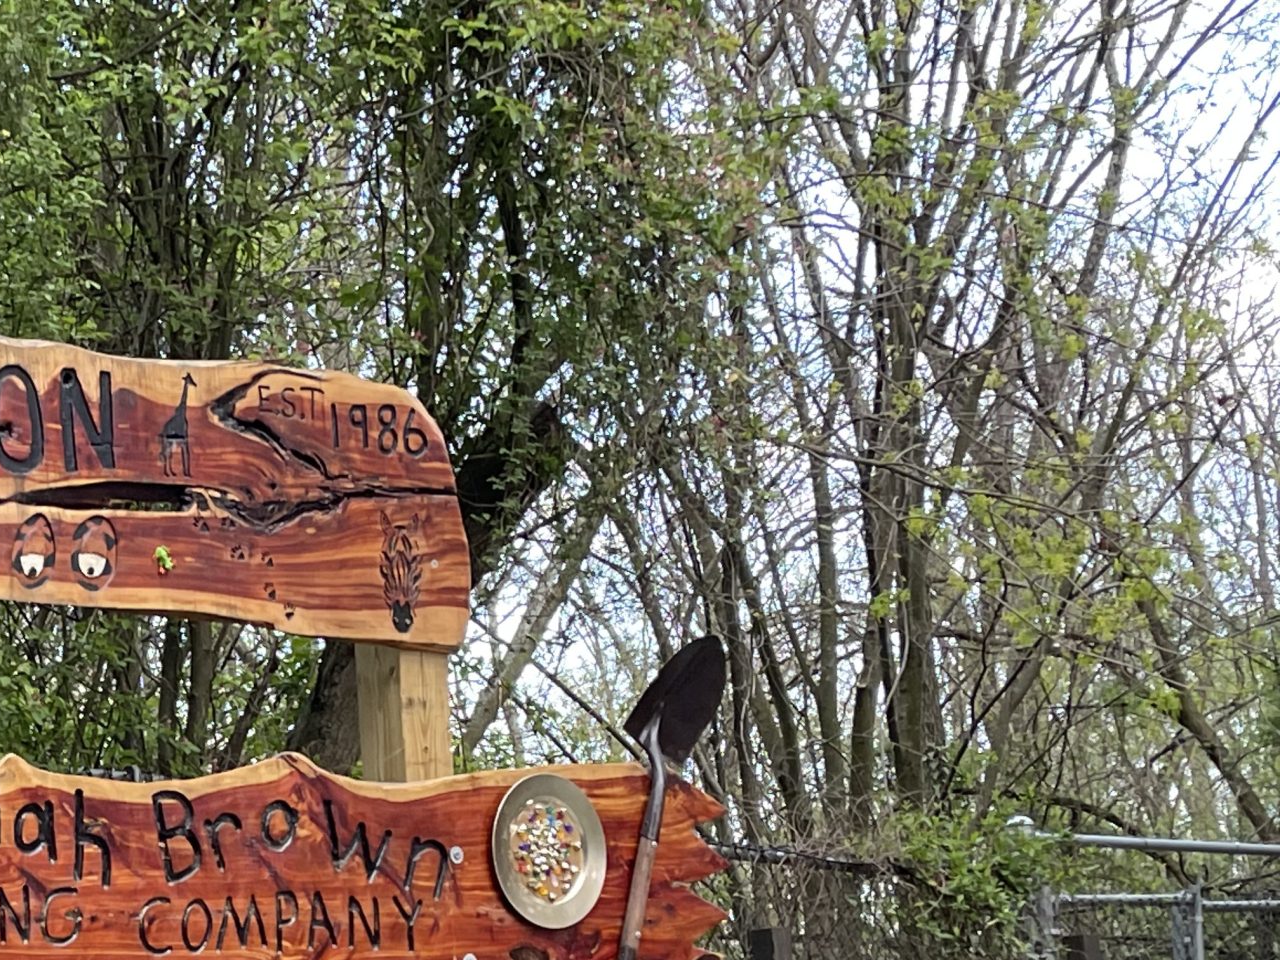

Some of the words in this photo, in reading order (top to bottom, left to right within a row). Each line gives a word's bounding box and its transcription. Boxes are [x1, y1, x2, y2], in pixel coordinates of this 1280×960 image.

[330, 402, 429, 458] 1986
[151, 789, 450, 900] Brown
[137, 890, 423, 955] COMPANY
